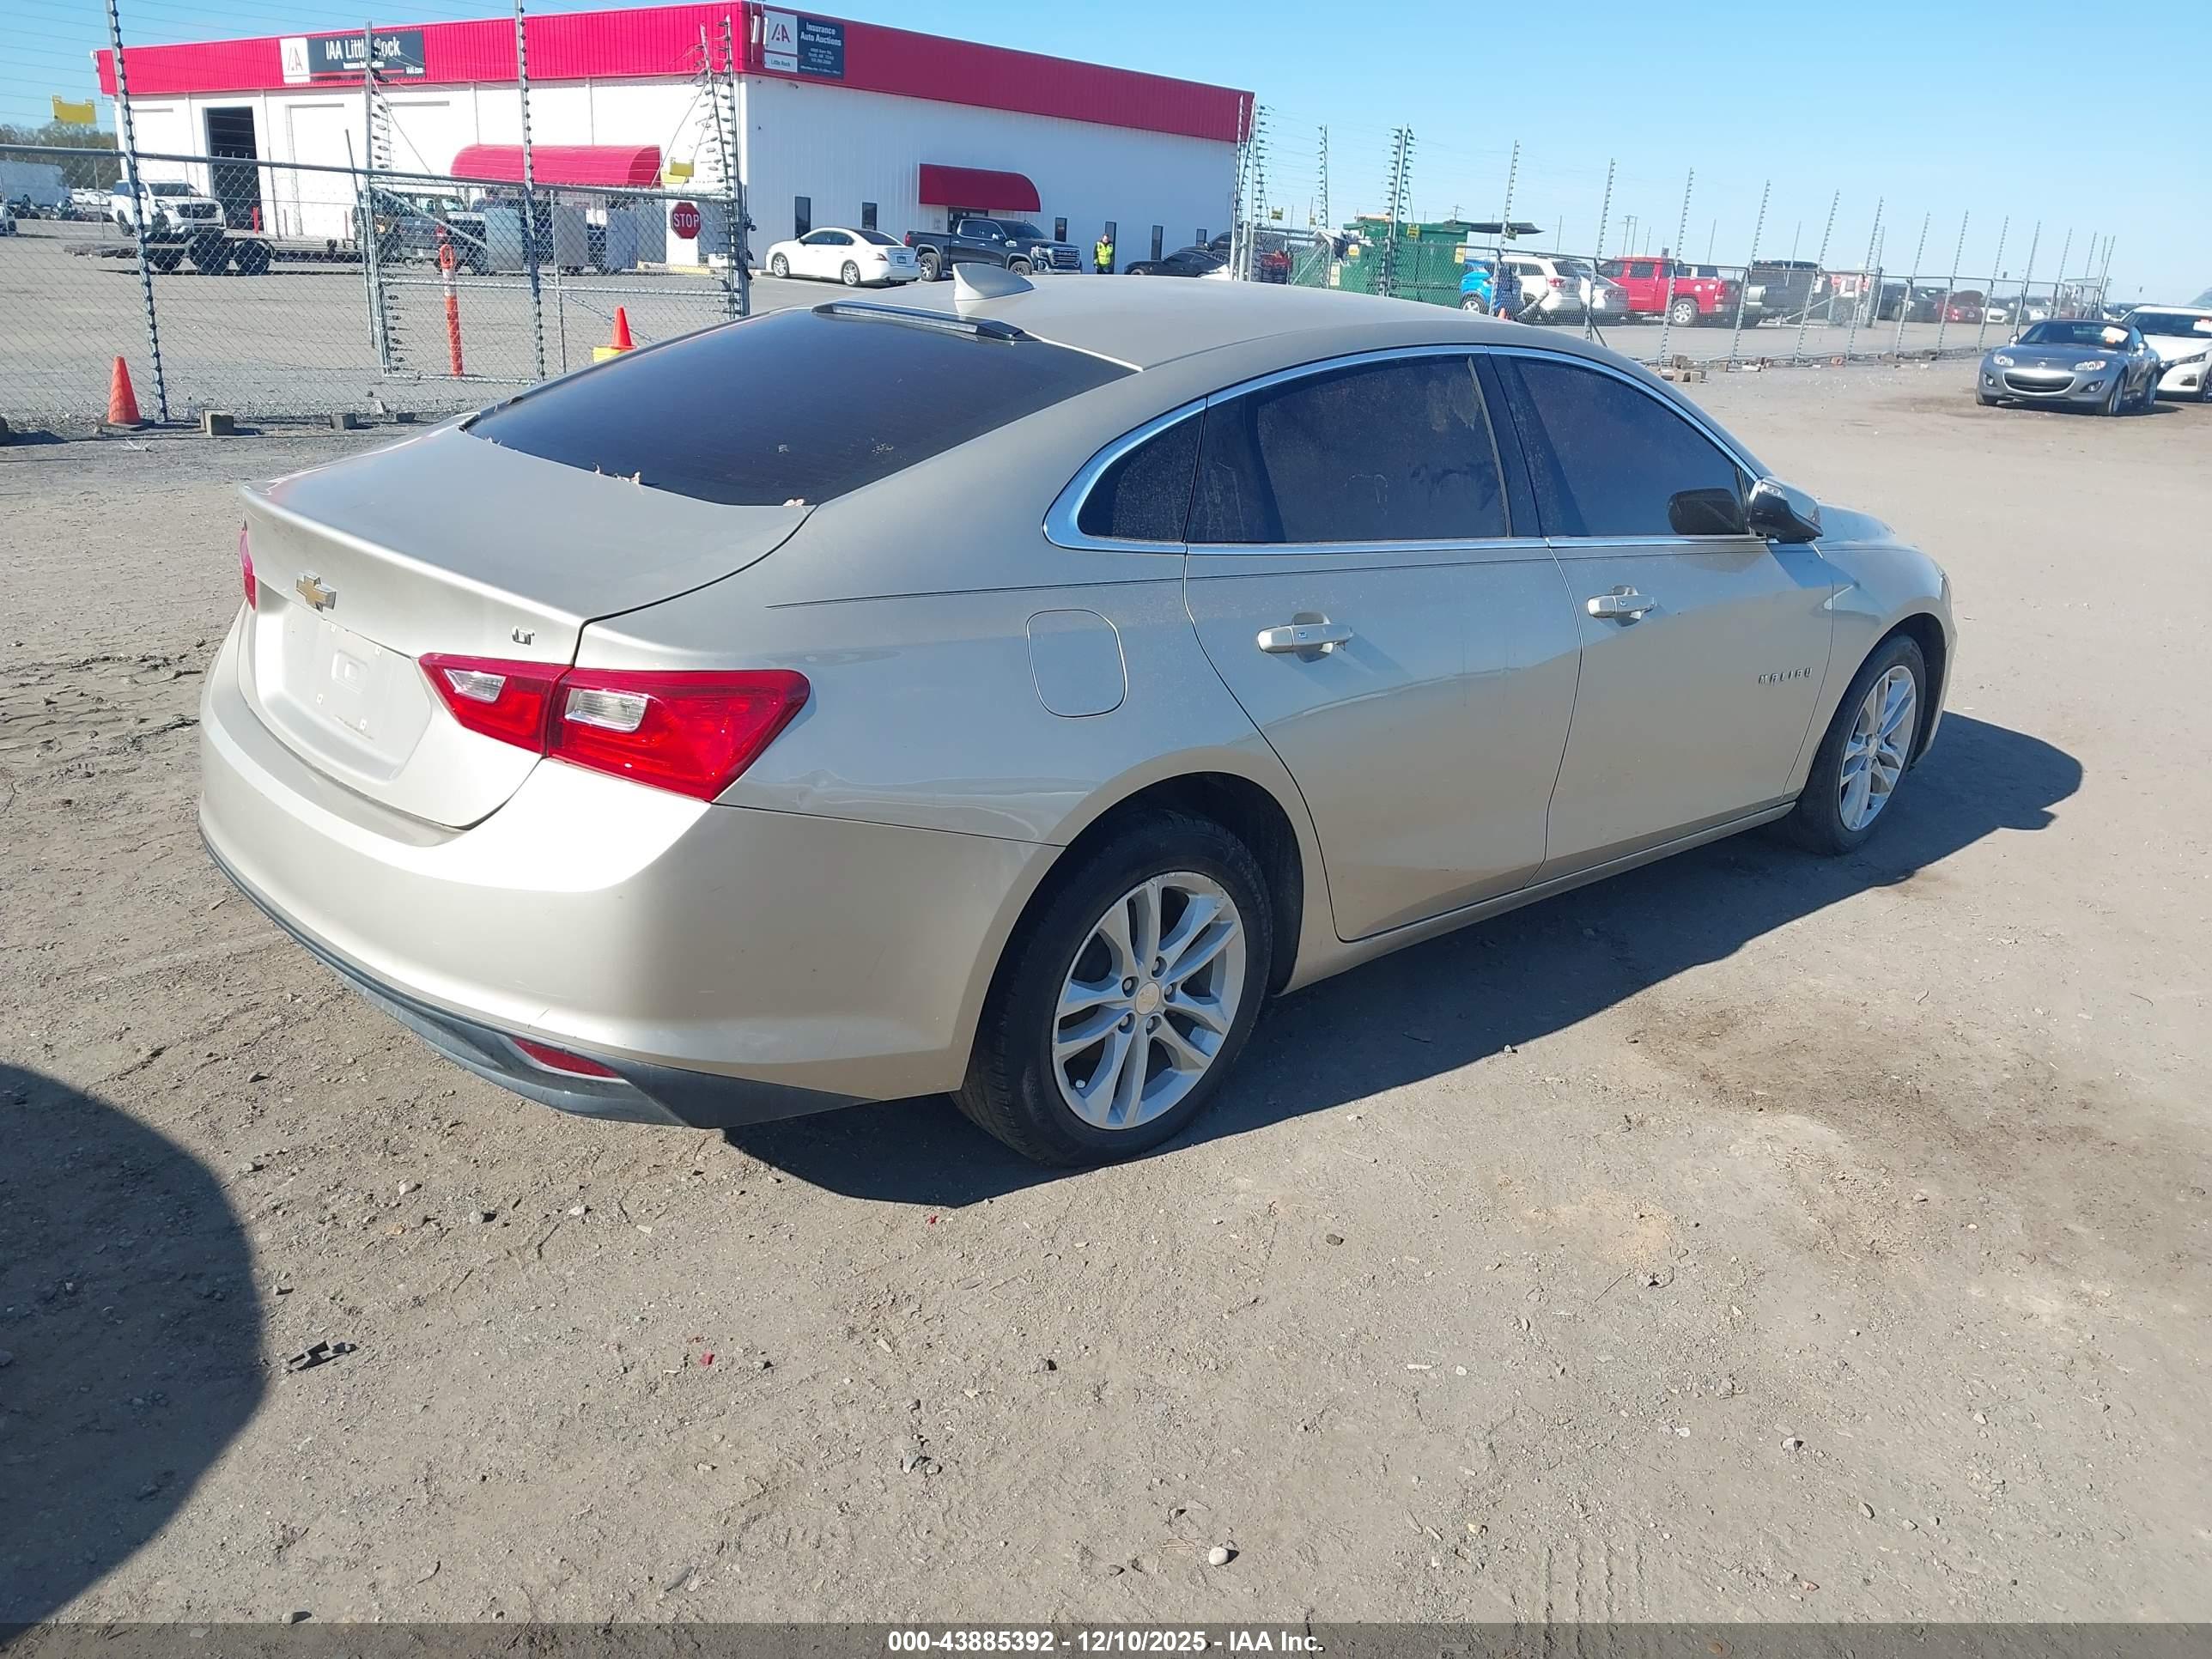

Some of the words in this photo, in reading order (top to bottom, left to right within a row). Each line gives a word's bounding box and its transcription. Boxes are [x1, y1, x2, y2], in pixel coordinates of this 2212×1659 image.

[805, 21, 836, 35] Insurance
[799, 31, 815, 42] Auto
[815, 33, 842, 46] Auctions
[325, 40, 343, 60] IAA
[344, 38, 367, 59] Littl
[673, 213, 700, 228] STOP
[511, 627, 536, 647] LT
[1758, 667, 1813, 686] MALIBU
